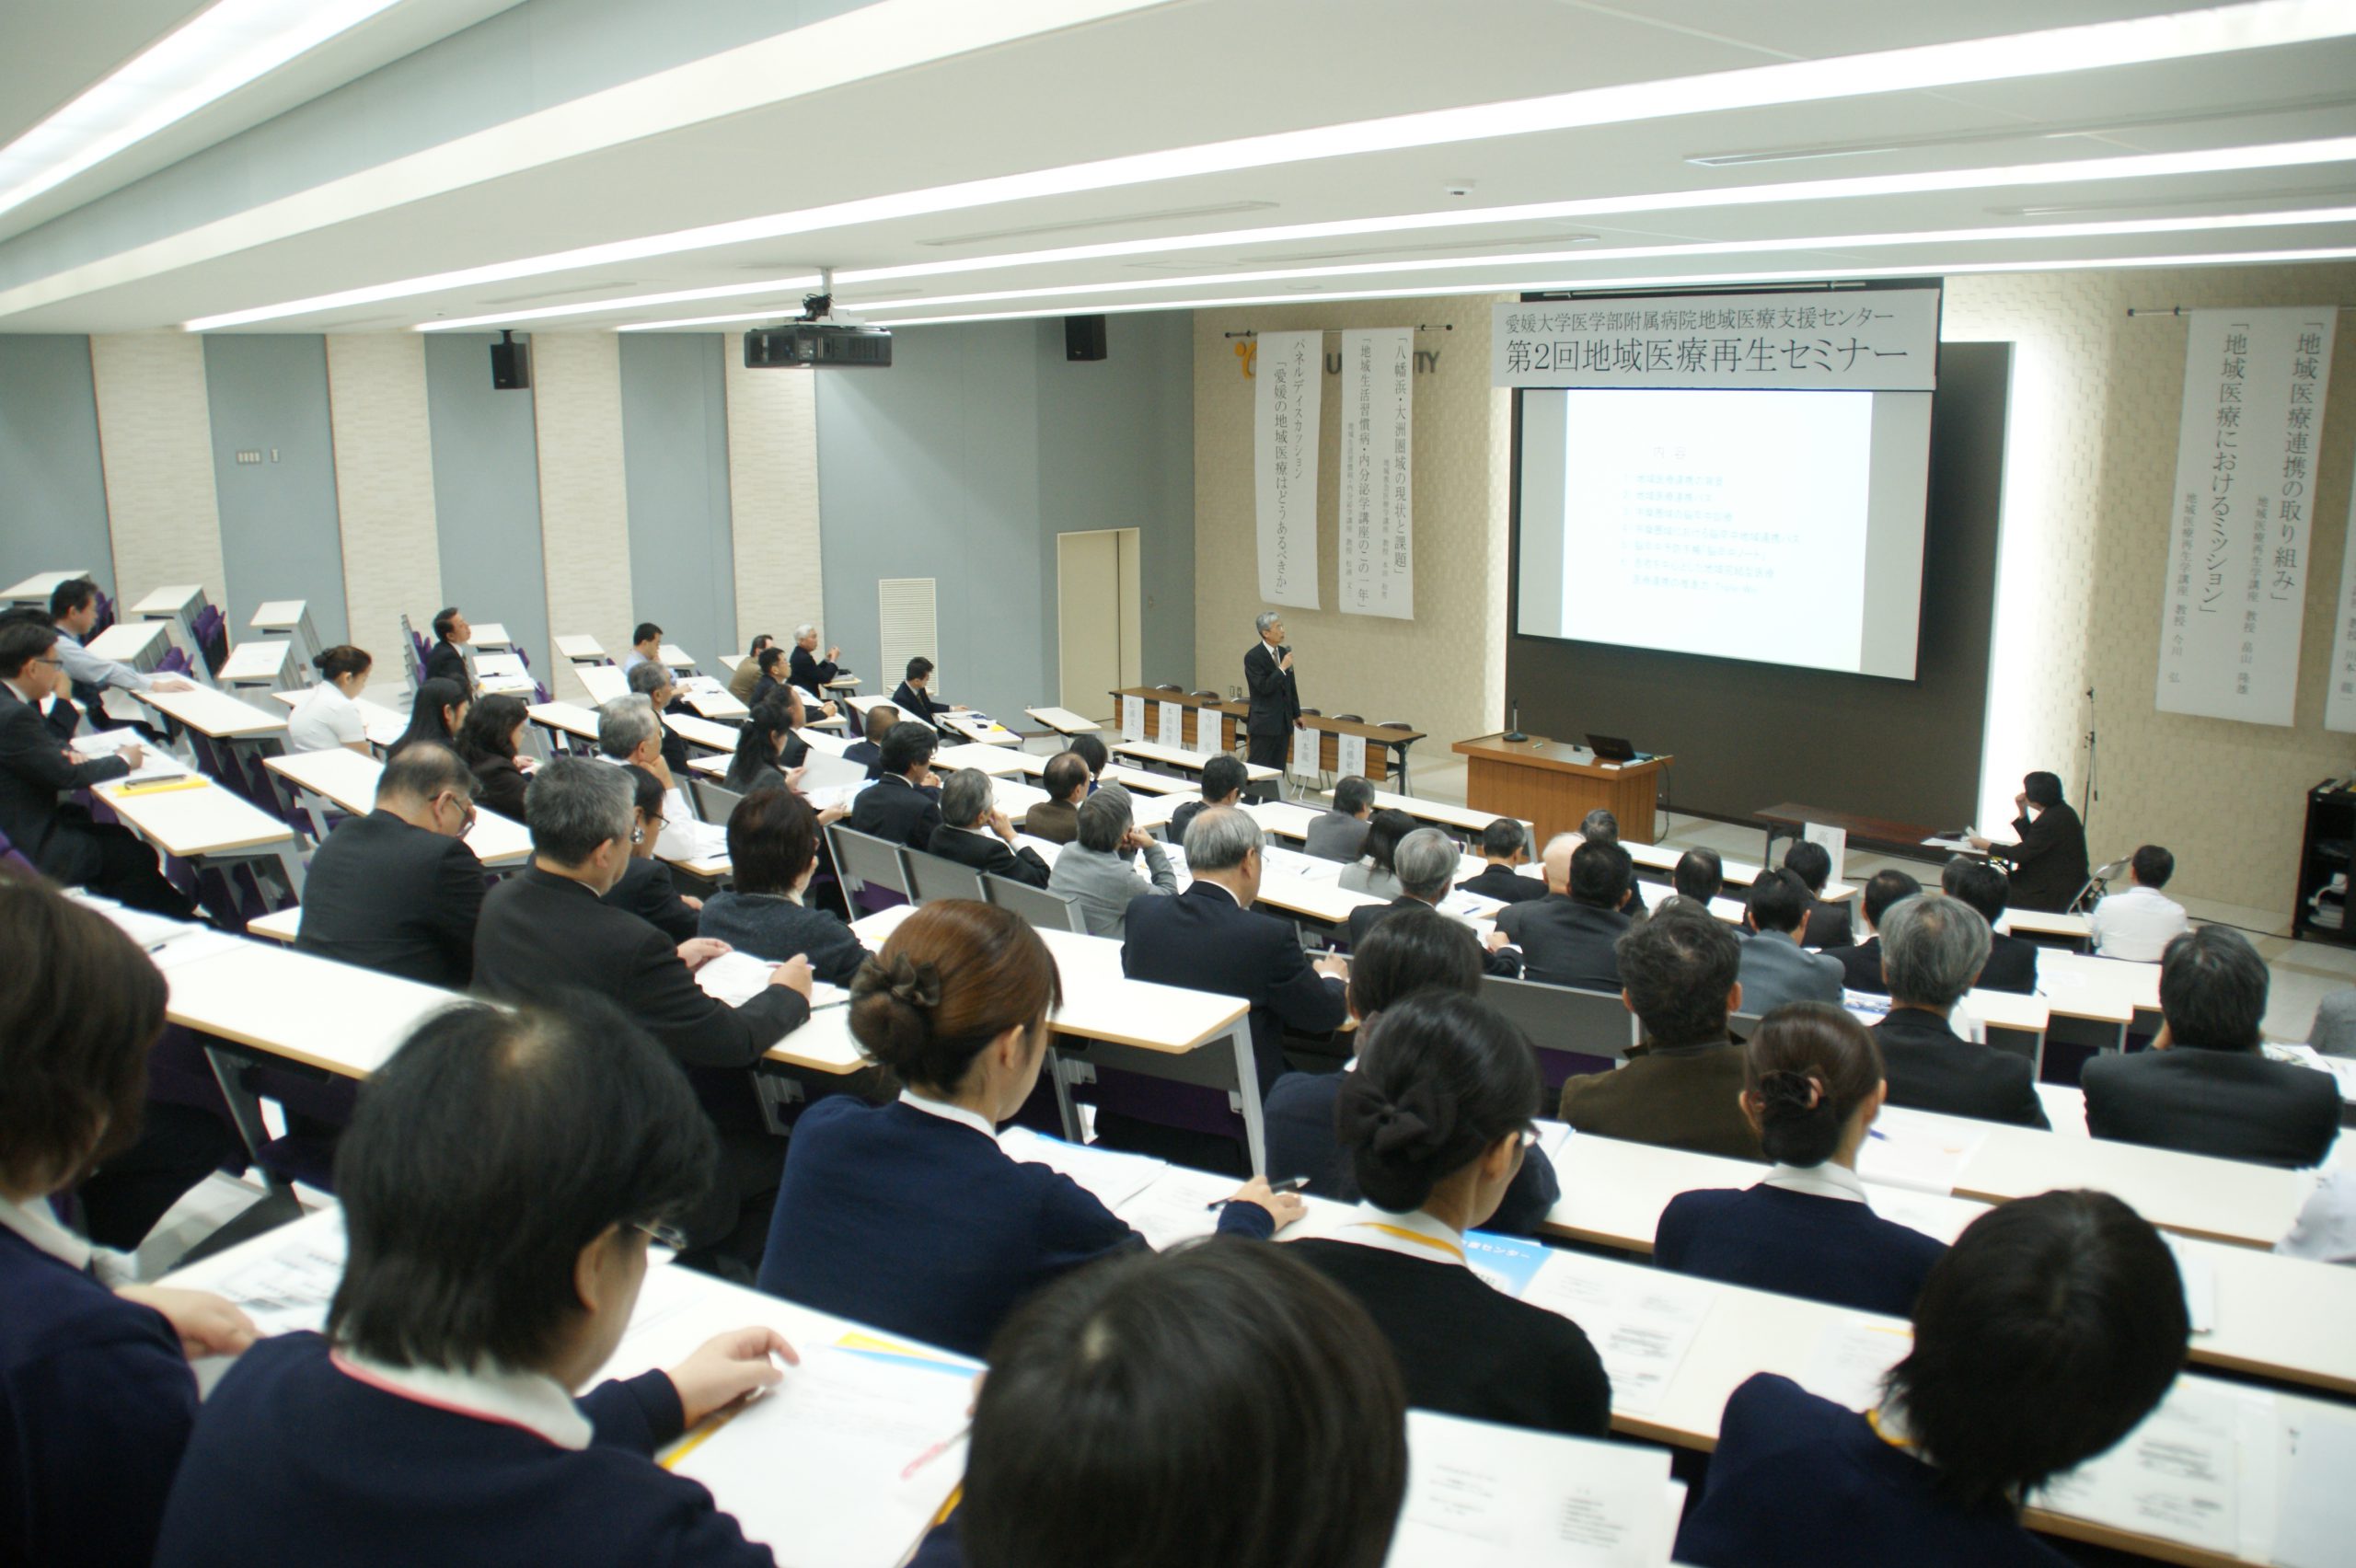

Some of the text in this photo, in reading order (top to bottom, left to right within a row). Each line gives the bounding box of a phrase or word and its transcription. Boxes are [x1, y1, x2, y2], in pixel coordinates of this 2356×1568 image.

[1293, 338, 1306, 479] パネルディスカッション
[1505, 306, 1894, 334] 愛媛大学医学部附属病院地域医療支援センター
[1506, 336, 1908, 374] 第2回地域医療再生セミナー
[1274, 361, 1288, 595] 「愛媛の地域医療はどうあるべきか」
[1393, 338, 1408, 574] 「八幡浜・大洲圏域の現状と課題」
[2198, 323, 2250, 613] 「地域医療におけるミッション」
[2269, 322, 2325, 602] 「地域医療連携の取り組み」
